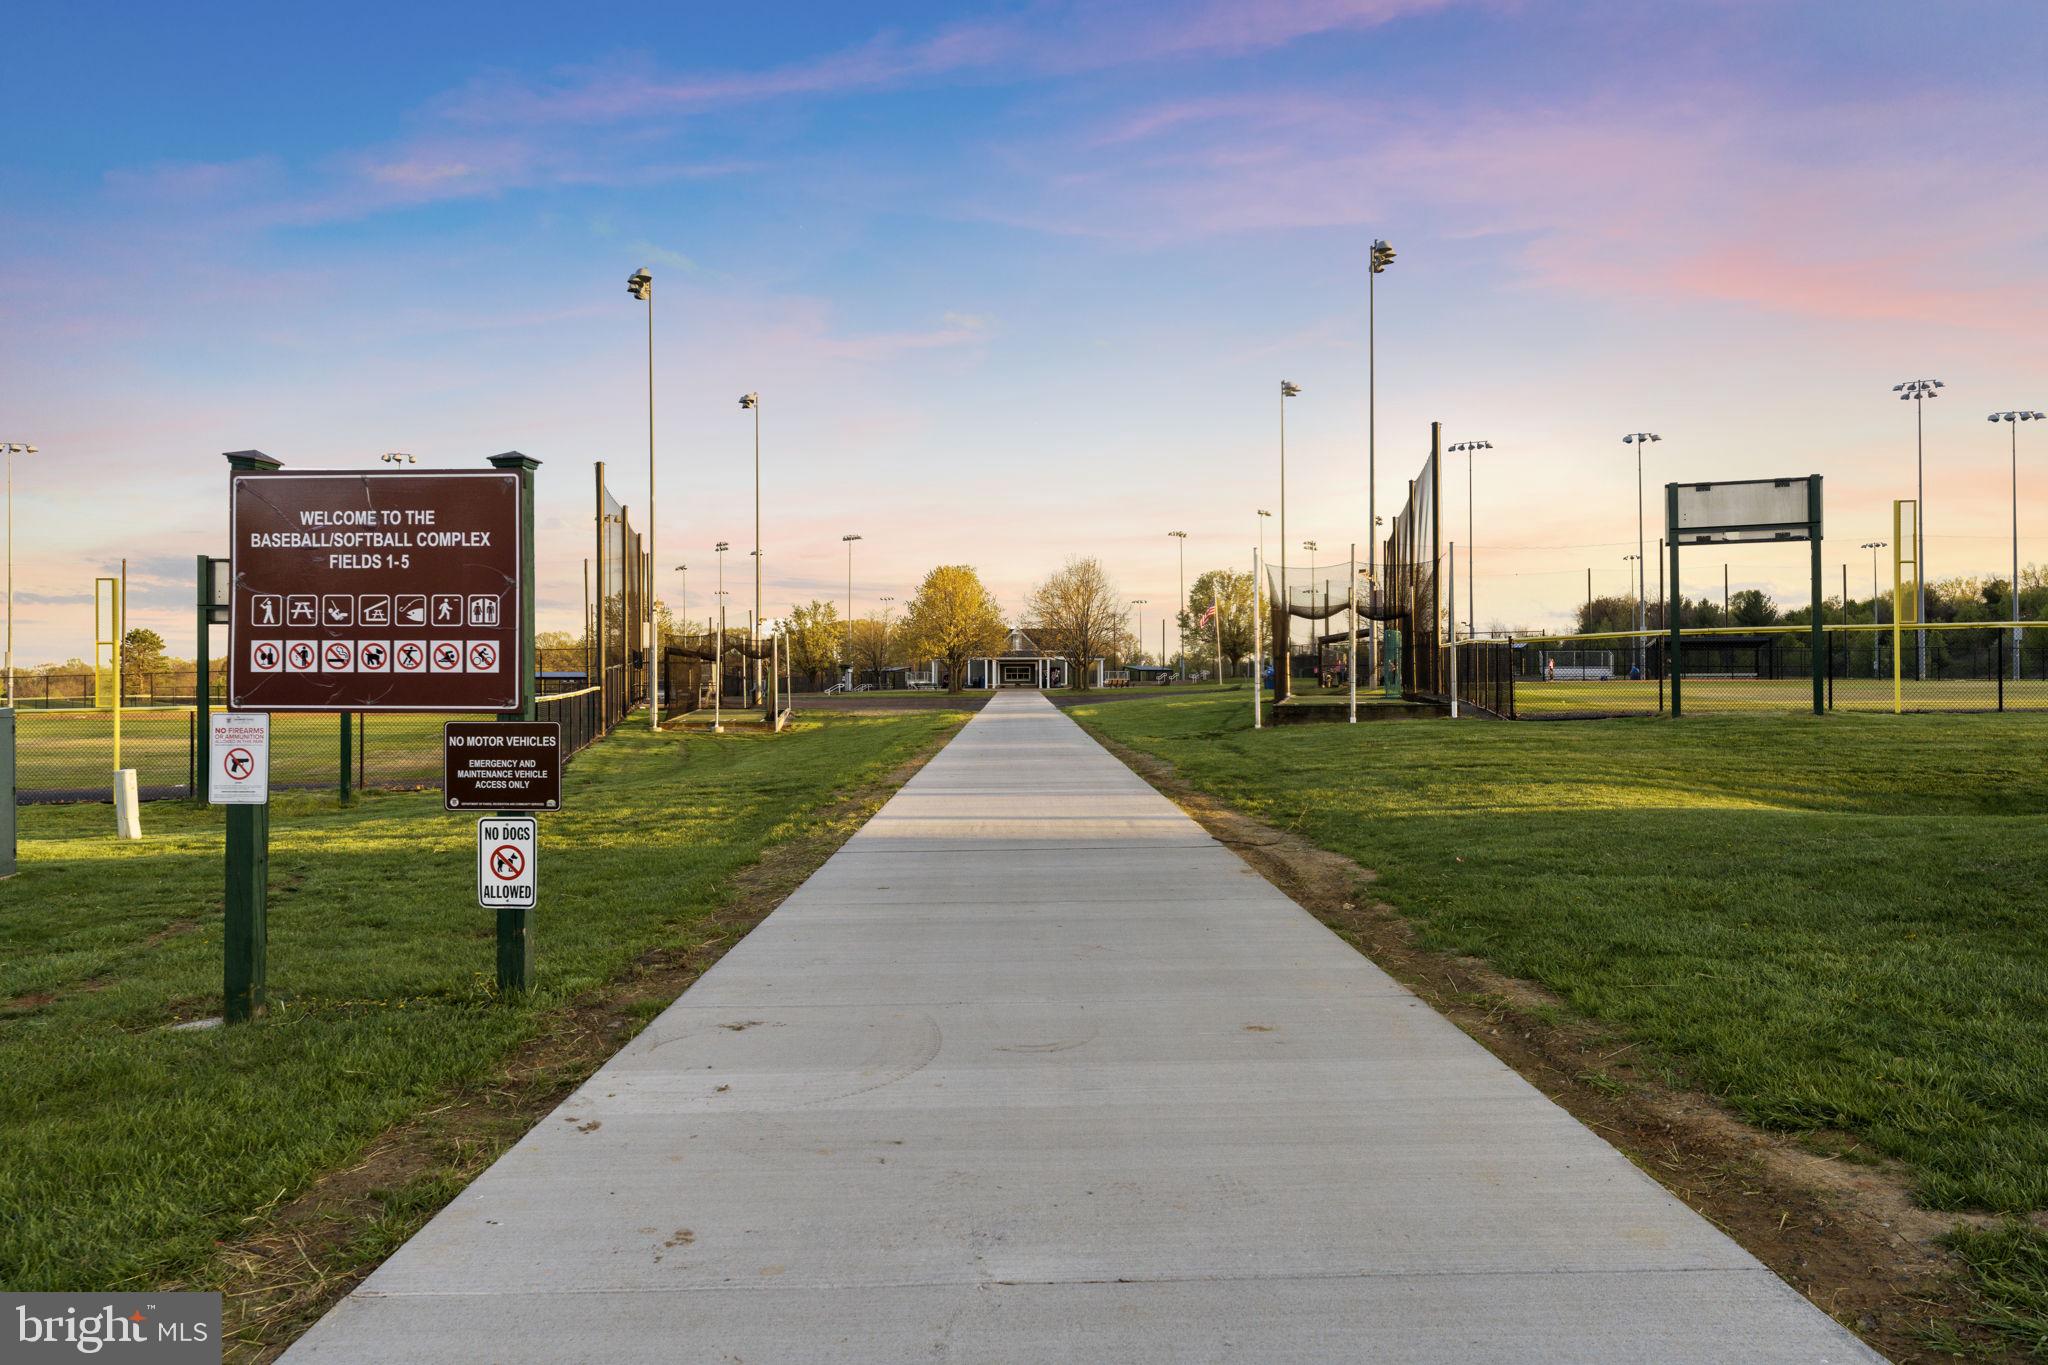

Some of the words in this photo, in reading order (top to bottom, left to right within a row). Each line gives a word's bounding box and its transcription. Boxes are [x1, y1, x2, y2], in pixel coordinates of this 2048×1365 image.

[299, 510, 377, 526] WELCOME
[381, 510, 402, 525] TO
[405, 510, 435, 525] THE
[251, 532, 413, 548] BASEBALL/SOFTBALL
[416, 531, 491, 547] COMPLEX
[329, 554, 382, 569] FIELDS
[449, 736, 465, 747] NO
[466, 736, 505, 747] MOTOR
[506, 736, 557, 747] VEHICLES
[469, 759, 520, 768] EMERGENCY
[519, 759, 536, 768] AND
[457, 770, 513, 778] MAINTENANCE
[514, 770, 548, 778] VEHICLE
[475, 780, 507, 789] ACCESS
[508, 780, 530, 789] ONLY
[484, 826, 499, 841] NO
[502, 826, 531, 841] DOGS
[483, 885, 532, 899] ALLOWED
